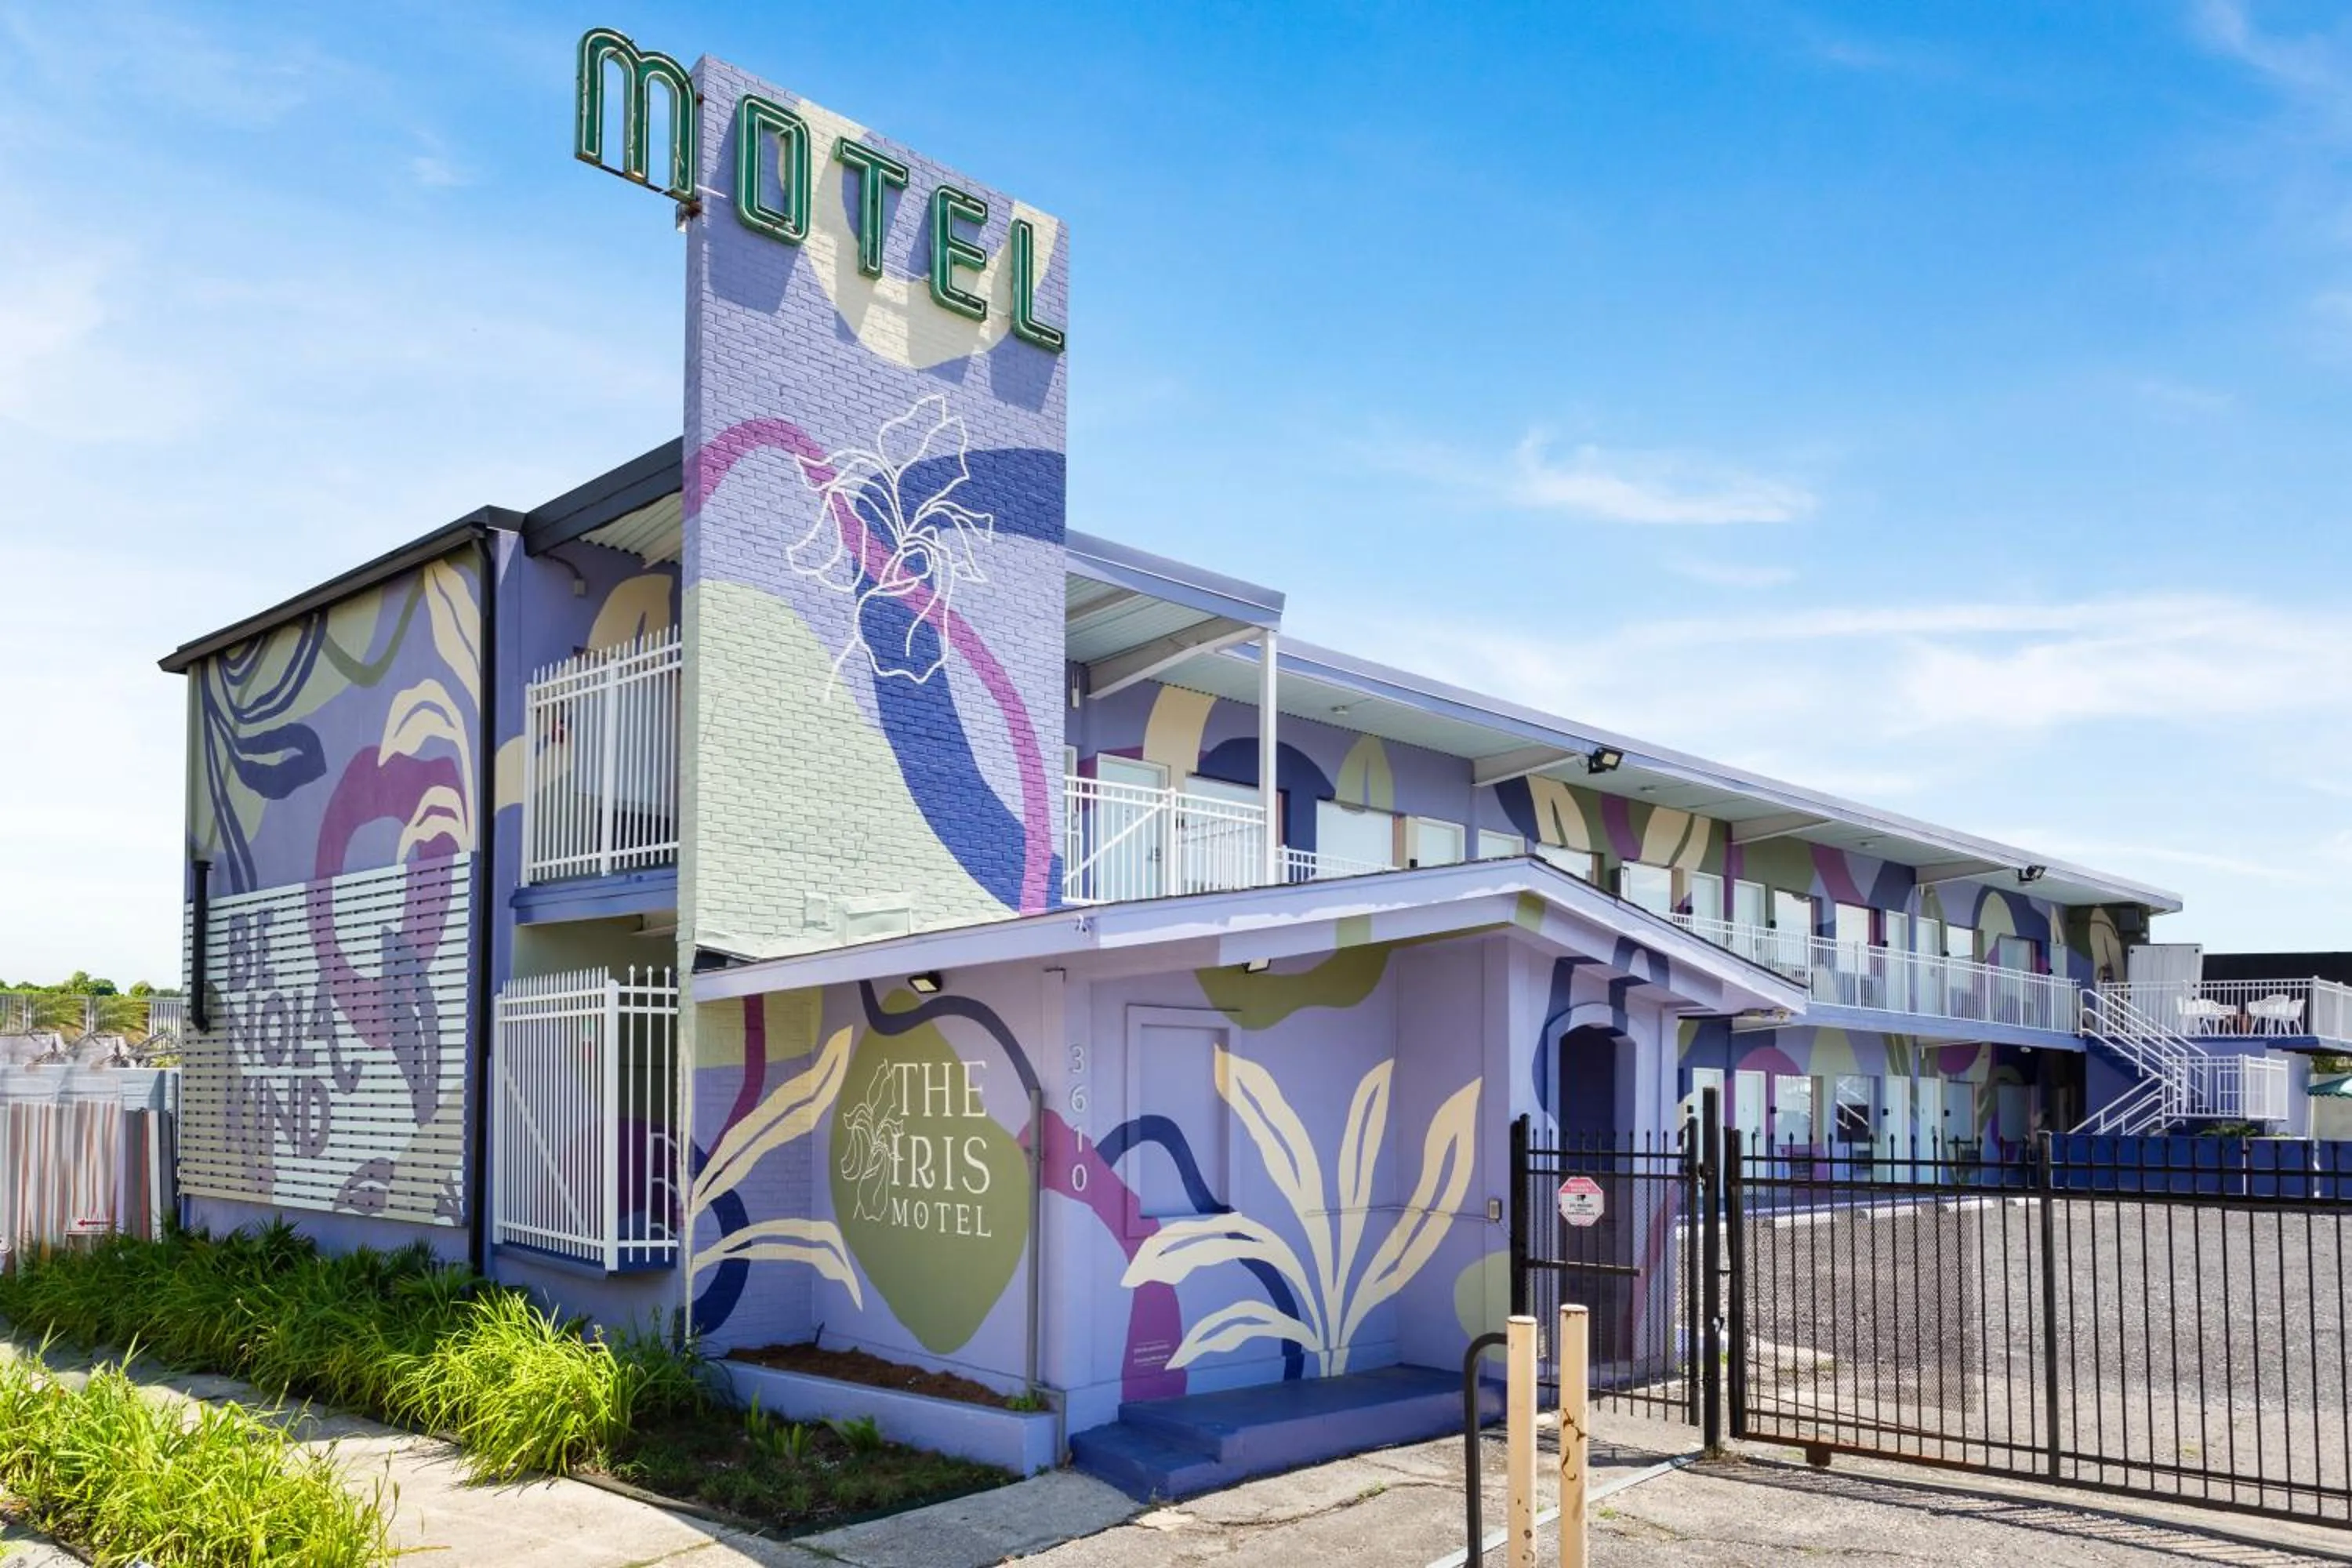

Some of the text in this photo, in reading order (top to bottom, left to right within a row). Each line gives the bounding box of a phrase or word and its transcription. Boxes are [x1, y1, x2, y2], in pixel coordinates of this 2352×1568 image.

[575, 27, 1065, 353] MOTEL
[228, 907, 275, 992] BE
[226, 980, 363, 1095] NOLA
[892, 1060, 988, 1118] THE
[1069, 1044, 1088, 1192] 3610
[891, 1135, 992, 1194] IRIS
[891, 1197, 993, 1238] MOTEL
